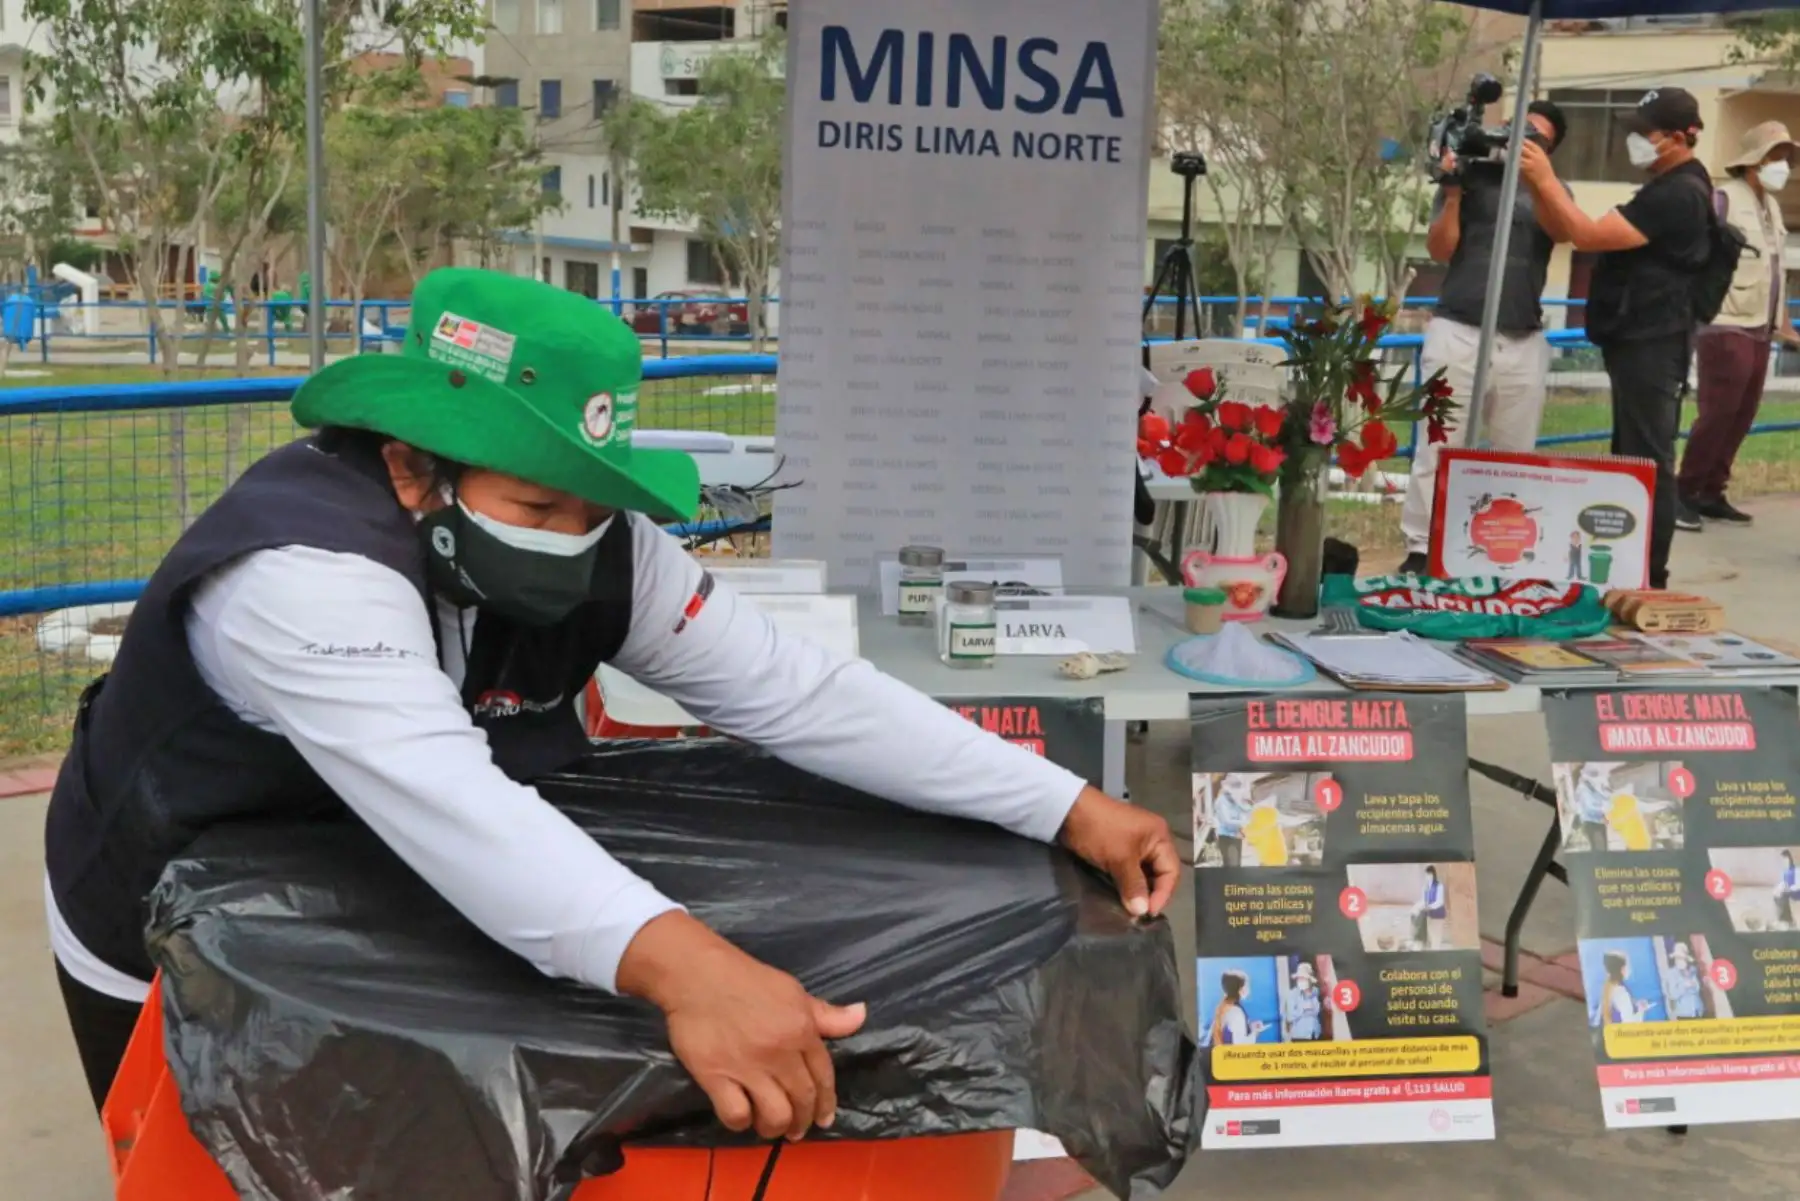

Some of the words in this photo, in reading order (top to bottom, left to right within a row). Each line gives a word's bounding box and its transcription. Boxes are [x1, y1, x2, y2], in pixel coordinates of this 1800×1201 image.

[820, 25, 1125, 118] MINSA
[818, 120, 903, 152] DIRIS
[915, 125, 1001, 157] LIMA
[1012, 130, 1122, 163] NORTE
[1005, 624, 1067, 639] LARVA
[962, 637, 996, 647] LARVA
[1247, 701, 1271, 729] EL
[1275, 699, 1349, 729] DENGUE
[1597, 694, 1619, 720] EL
[1622, 694, 1692, 721] DENGUE
[1255, 735, 1302, 757] ¡MATA
[1306, 736, 1327, 757] AL
[1328, 734, 1405, 757] ZANCUDO!
[1656, 726, 1675, 747] AL
[1676, 775, 1686, 793] 1
[1322, 787, 1333, 805] 1
[1363, 792, 1388, 805] Lava
[1388, 796, 1397, 808] y
[1424, 791, 1440, 805] los
[1356, 808, 1413, 822] recipientes
[1415, 806, 1450, 819] donde
[1224, 884, 1265, 897] Elimina
[1266, 883, 1282, 896] las
[1284, 885, 1314, 896] cosas
[1713, 876, 1725, 894] 2
[1225, 902, 1247, 914] que
[1249, 901, 1264, 911] no
[1266, 897, 1304, 911] utilices
[1306, 899, 1314, 911] y
[1347, 893, 1360, 912] 2
[1228, 917, 1250, 929] que
[1252, 912, 1312, 926] almacenen
[1255, 930, 1287, 944] agua.
[1379, 969, 1428, 982] Colabora
[1430, 970, 1449, 981] con
[1450, 966, 1461, 980] el
[1716, 965, 1729, 985] 3
[1340, 987, 1353, 1006] 3
[1390, 983, 1437, 998] personal
[1439, 983, 1453, 995] de
[1386, 998, 1417, 1011] salud
[1418, 998, 1458, 1010] cuando
[1386, 1013, 1416, 1026] visite
[1418, 1012, 1430, 1024] tu
[1228, 1089, 1250, 1102] Para
[1252, 1088, 1274, 1100] más
[1275, 1086, 1334, 1099] información
[1433, 1080, 1466, 1093] SALUD
